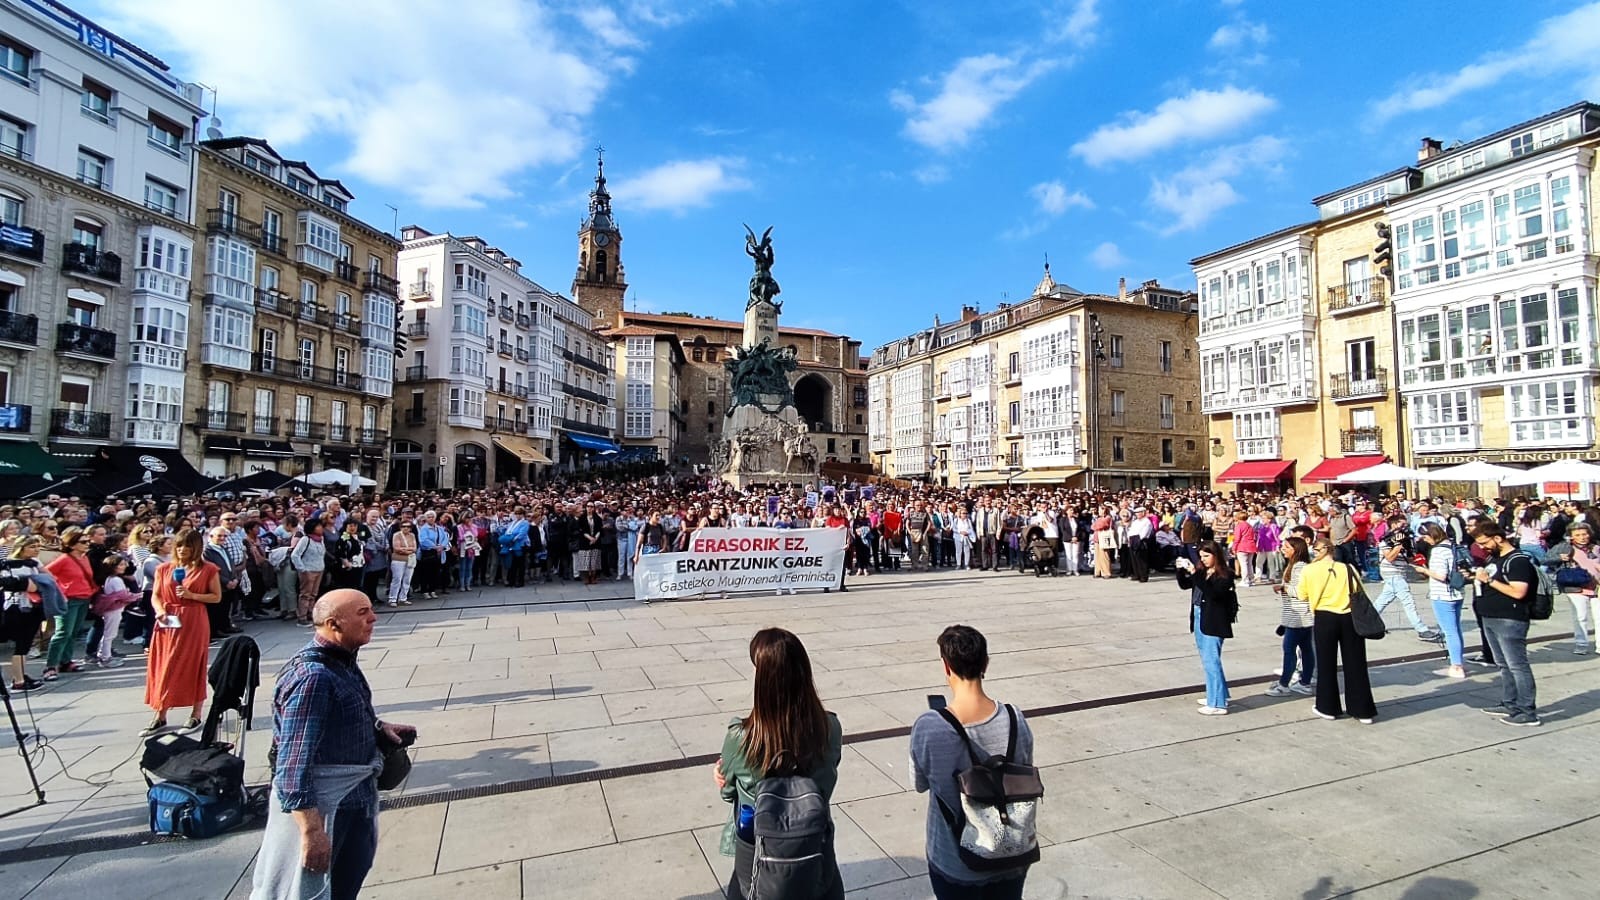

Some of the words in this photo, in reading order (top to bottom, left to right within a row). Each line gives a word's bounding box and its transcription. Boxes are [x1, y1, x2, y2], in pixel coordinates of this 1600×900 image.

[1423, 455, 1488, 464] TEJIDOS
[694, 537, 781, 553] ERASORIK
[784, 537, 809, 553] EZ,
[676, 557, 780, 574] ERANTZUNIK
[782, 556, 824, 568] GABE
[659, 576, 715, 593] Gasteizko
[718, 573, 783, 588] Mugimendu
[784, 571, 836, 583] Feminista
